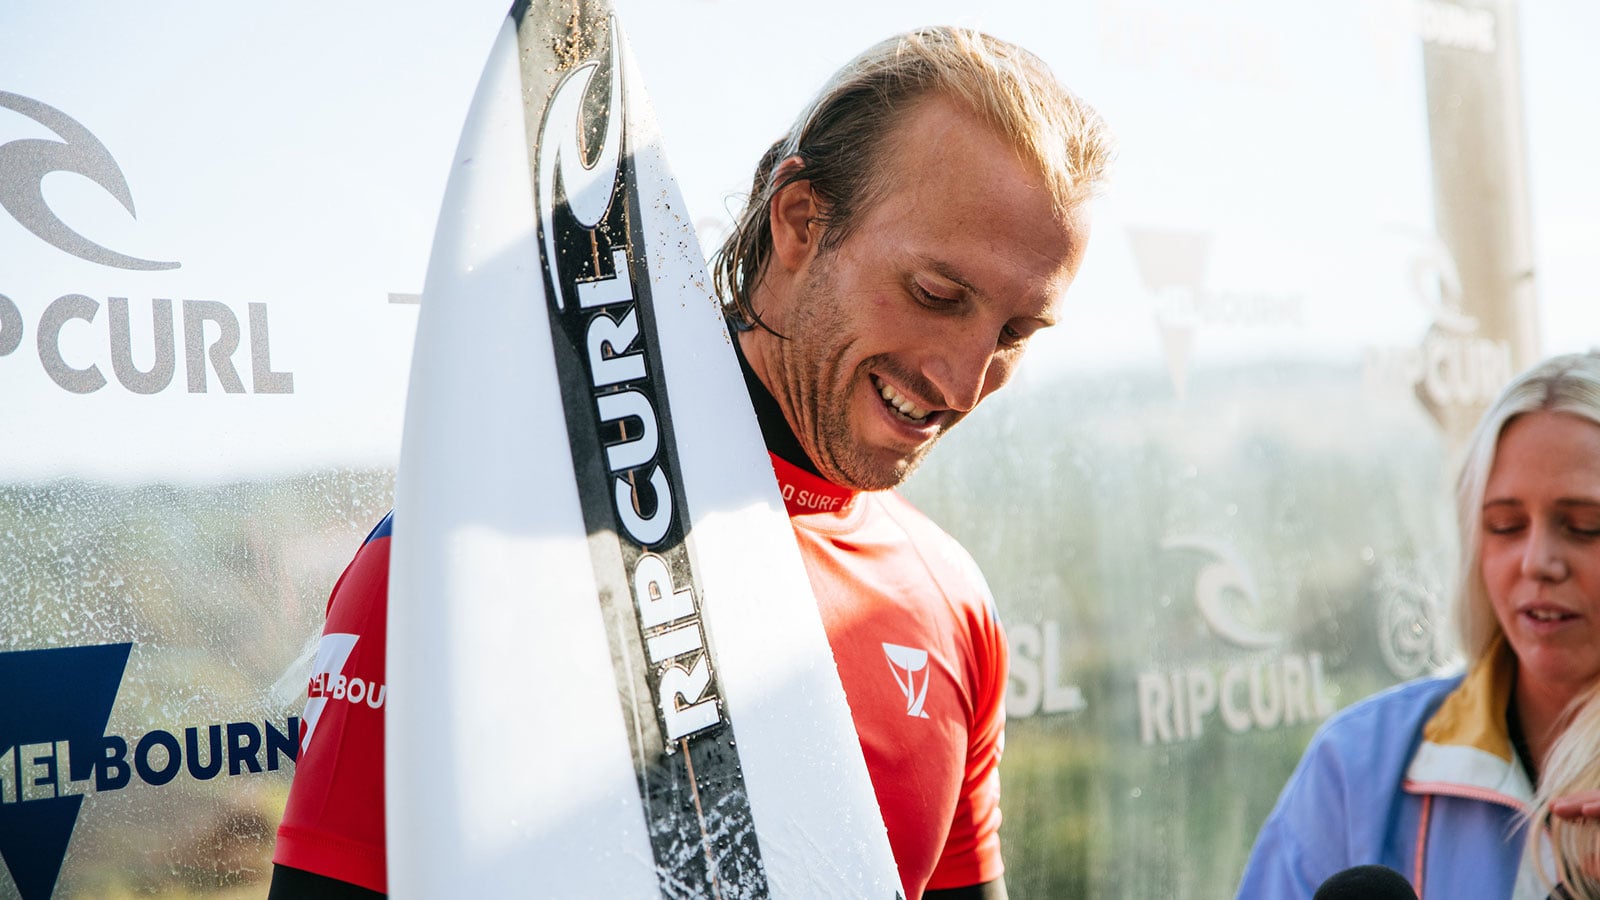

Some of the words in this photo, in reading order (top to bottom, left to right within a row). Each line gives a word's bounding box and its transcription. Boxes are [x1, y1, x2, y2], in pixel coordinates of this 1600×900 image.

[37, 293, 294, 394] CURL
[577, 246, 674, 546] CURL
[796, 490, 842, 511] SURF
[308, 672, 386, 710] ELBOU
[634, 554, 722, 741] RIP
[1007, 620, 1085, 719] SL
[0, 716, 300, 804] ELBOURN
